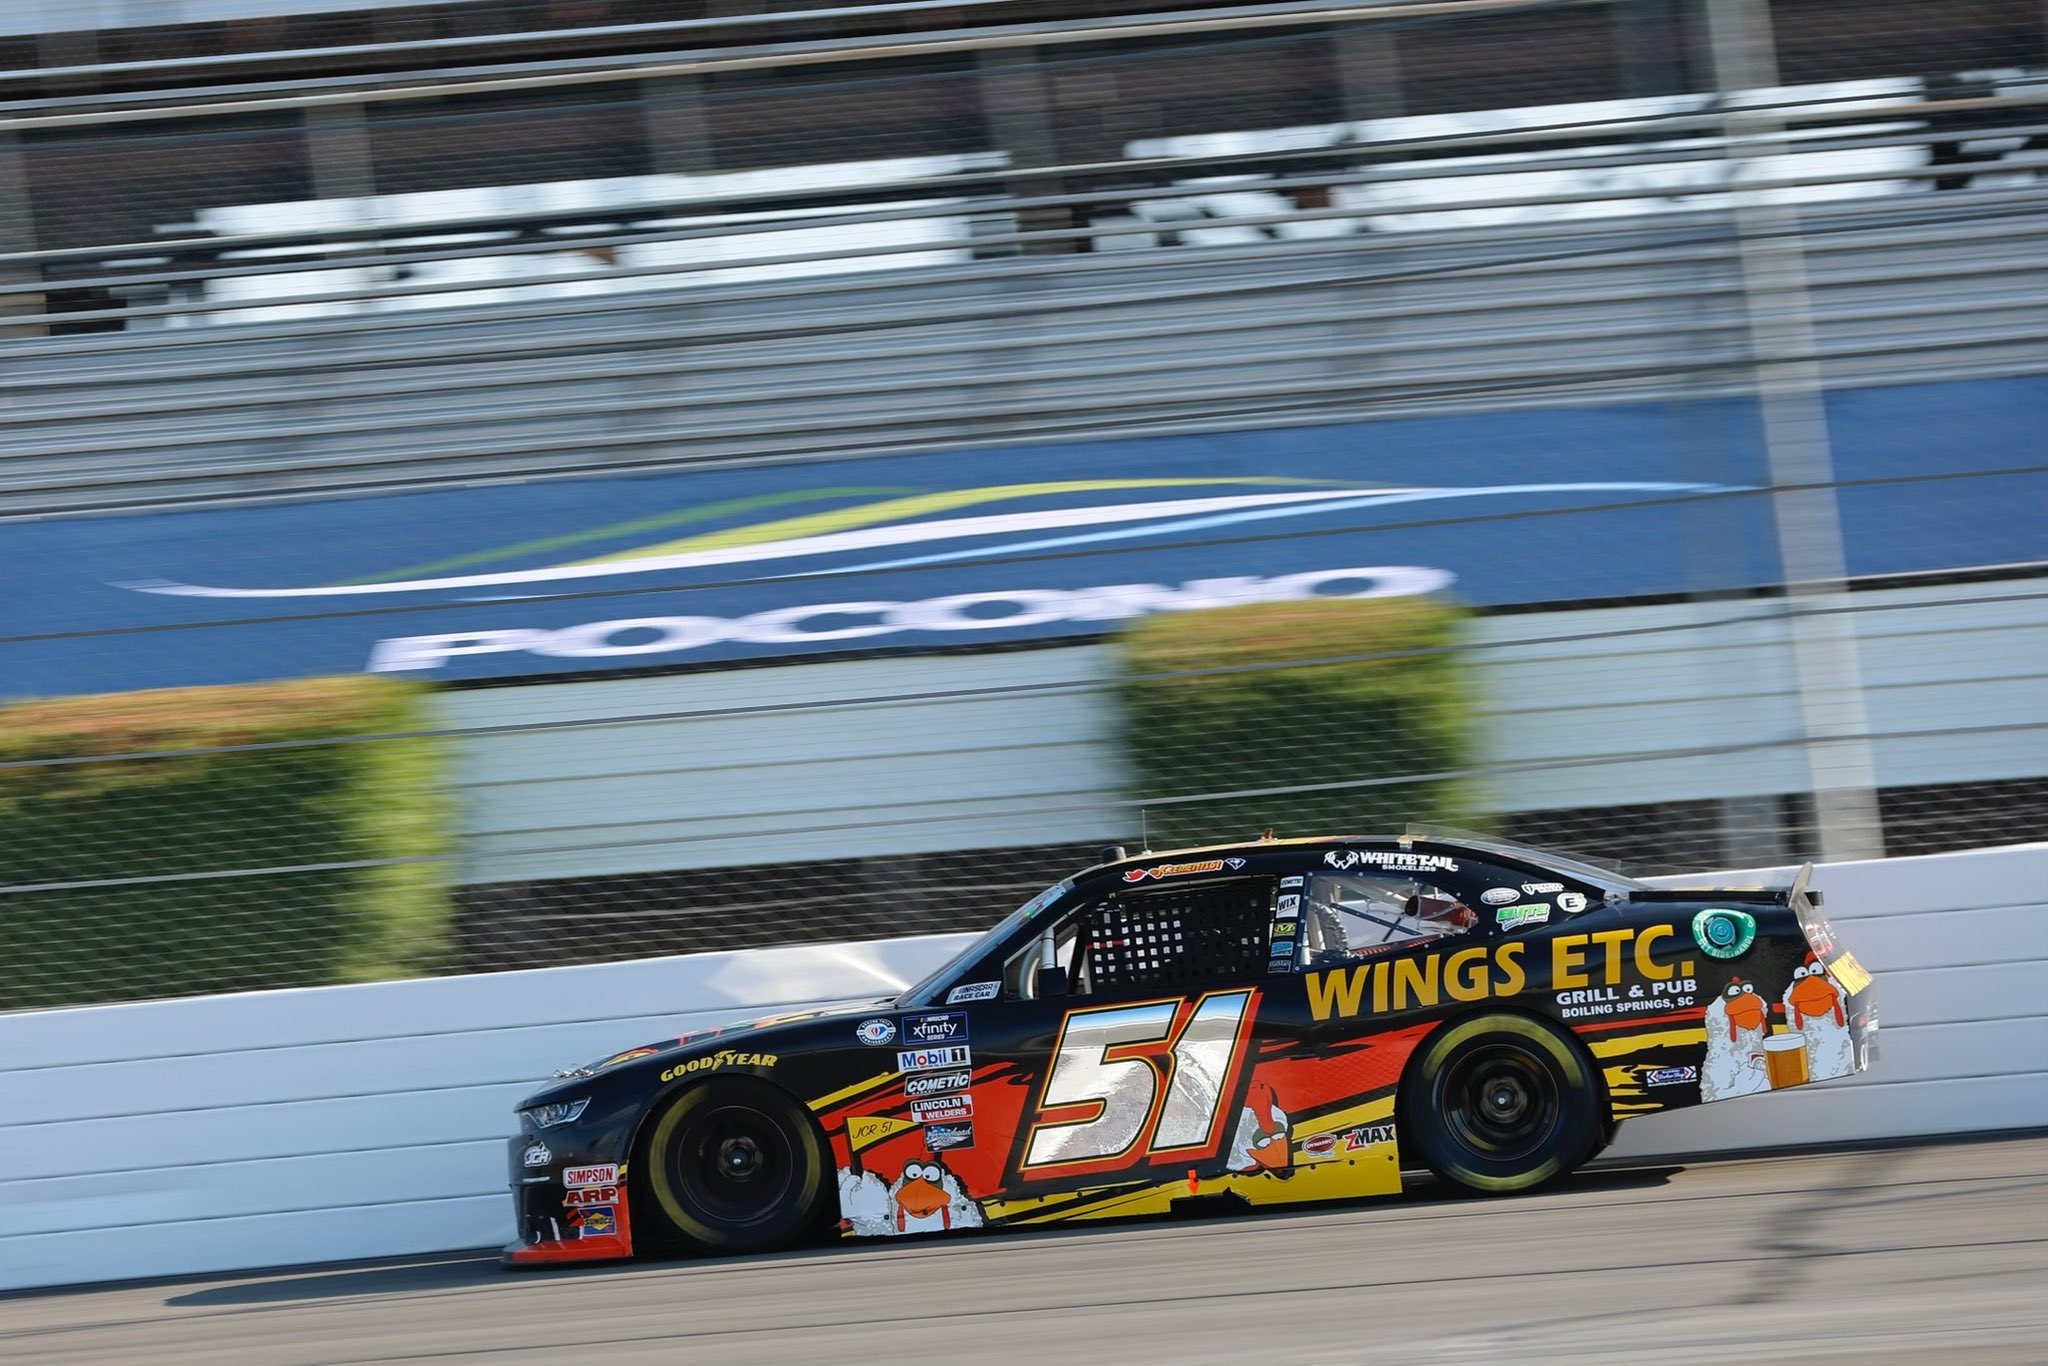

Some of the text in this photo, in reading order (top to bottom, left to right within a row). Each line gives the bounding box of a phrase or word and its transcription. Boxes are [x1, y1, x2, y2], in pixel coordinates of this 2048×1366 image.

[1360, 851, 1459, 872] WHITETAIL
[1382, 864, 1437, 872] SMOKELESS
[1278, 896, 1297, 912] WIX
[1305, 924, 1695, 1022] WINGS ETC.
[953, 990, 991, 1001] RACE CAR
[961, 983, 994, 993] NASCAR
[1556, 979, 1698, 1005] GRILL & PUB
[1561, 996, 1695, 1018] BOILING SPRINGS, SC
[913, 1022, 957, 1039] xfinity
[926, 1033, 946, 1041] SERIES
[660, 1050, 778, 1082] GOODYEAR
[902, 1050, 947, 1067] Mobil
[907, 1073, 969, 1093] COMETIC
[1019, 986, 1258, 1172] 51
[914, 1098, 961, 1112] LINCOLN
[925, 1108, 967, 1119] WELDERS
[853, 1121, 893, 1139] JCR 51
[567, 1167, 614, 1185] SIMPSON
[566, 1188, 617, 1205] ARP
